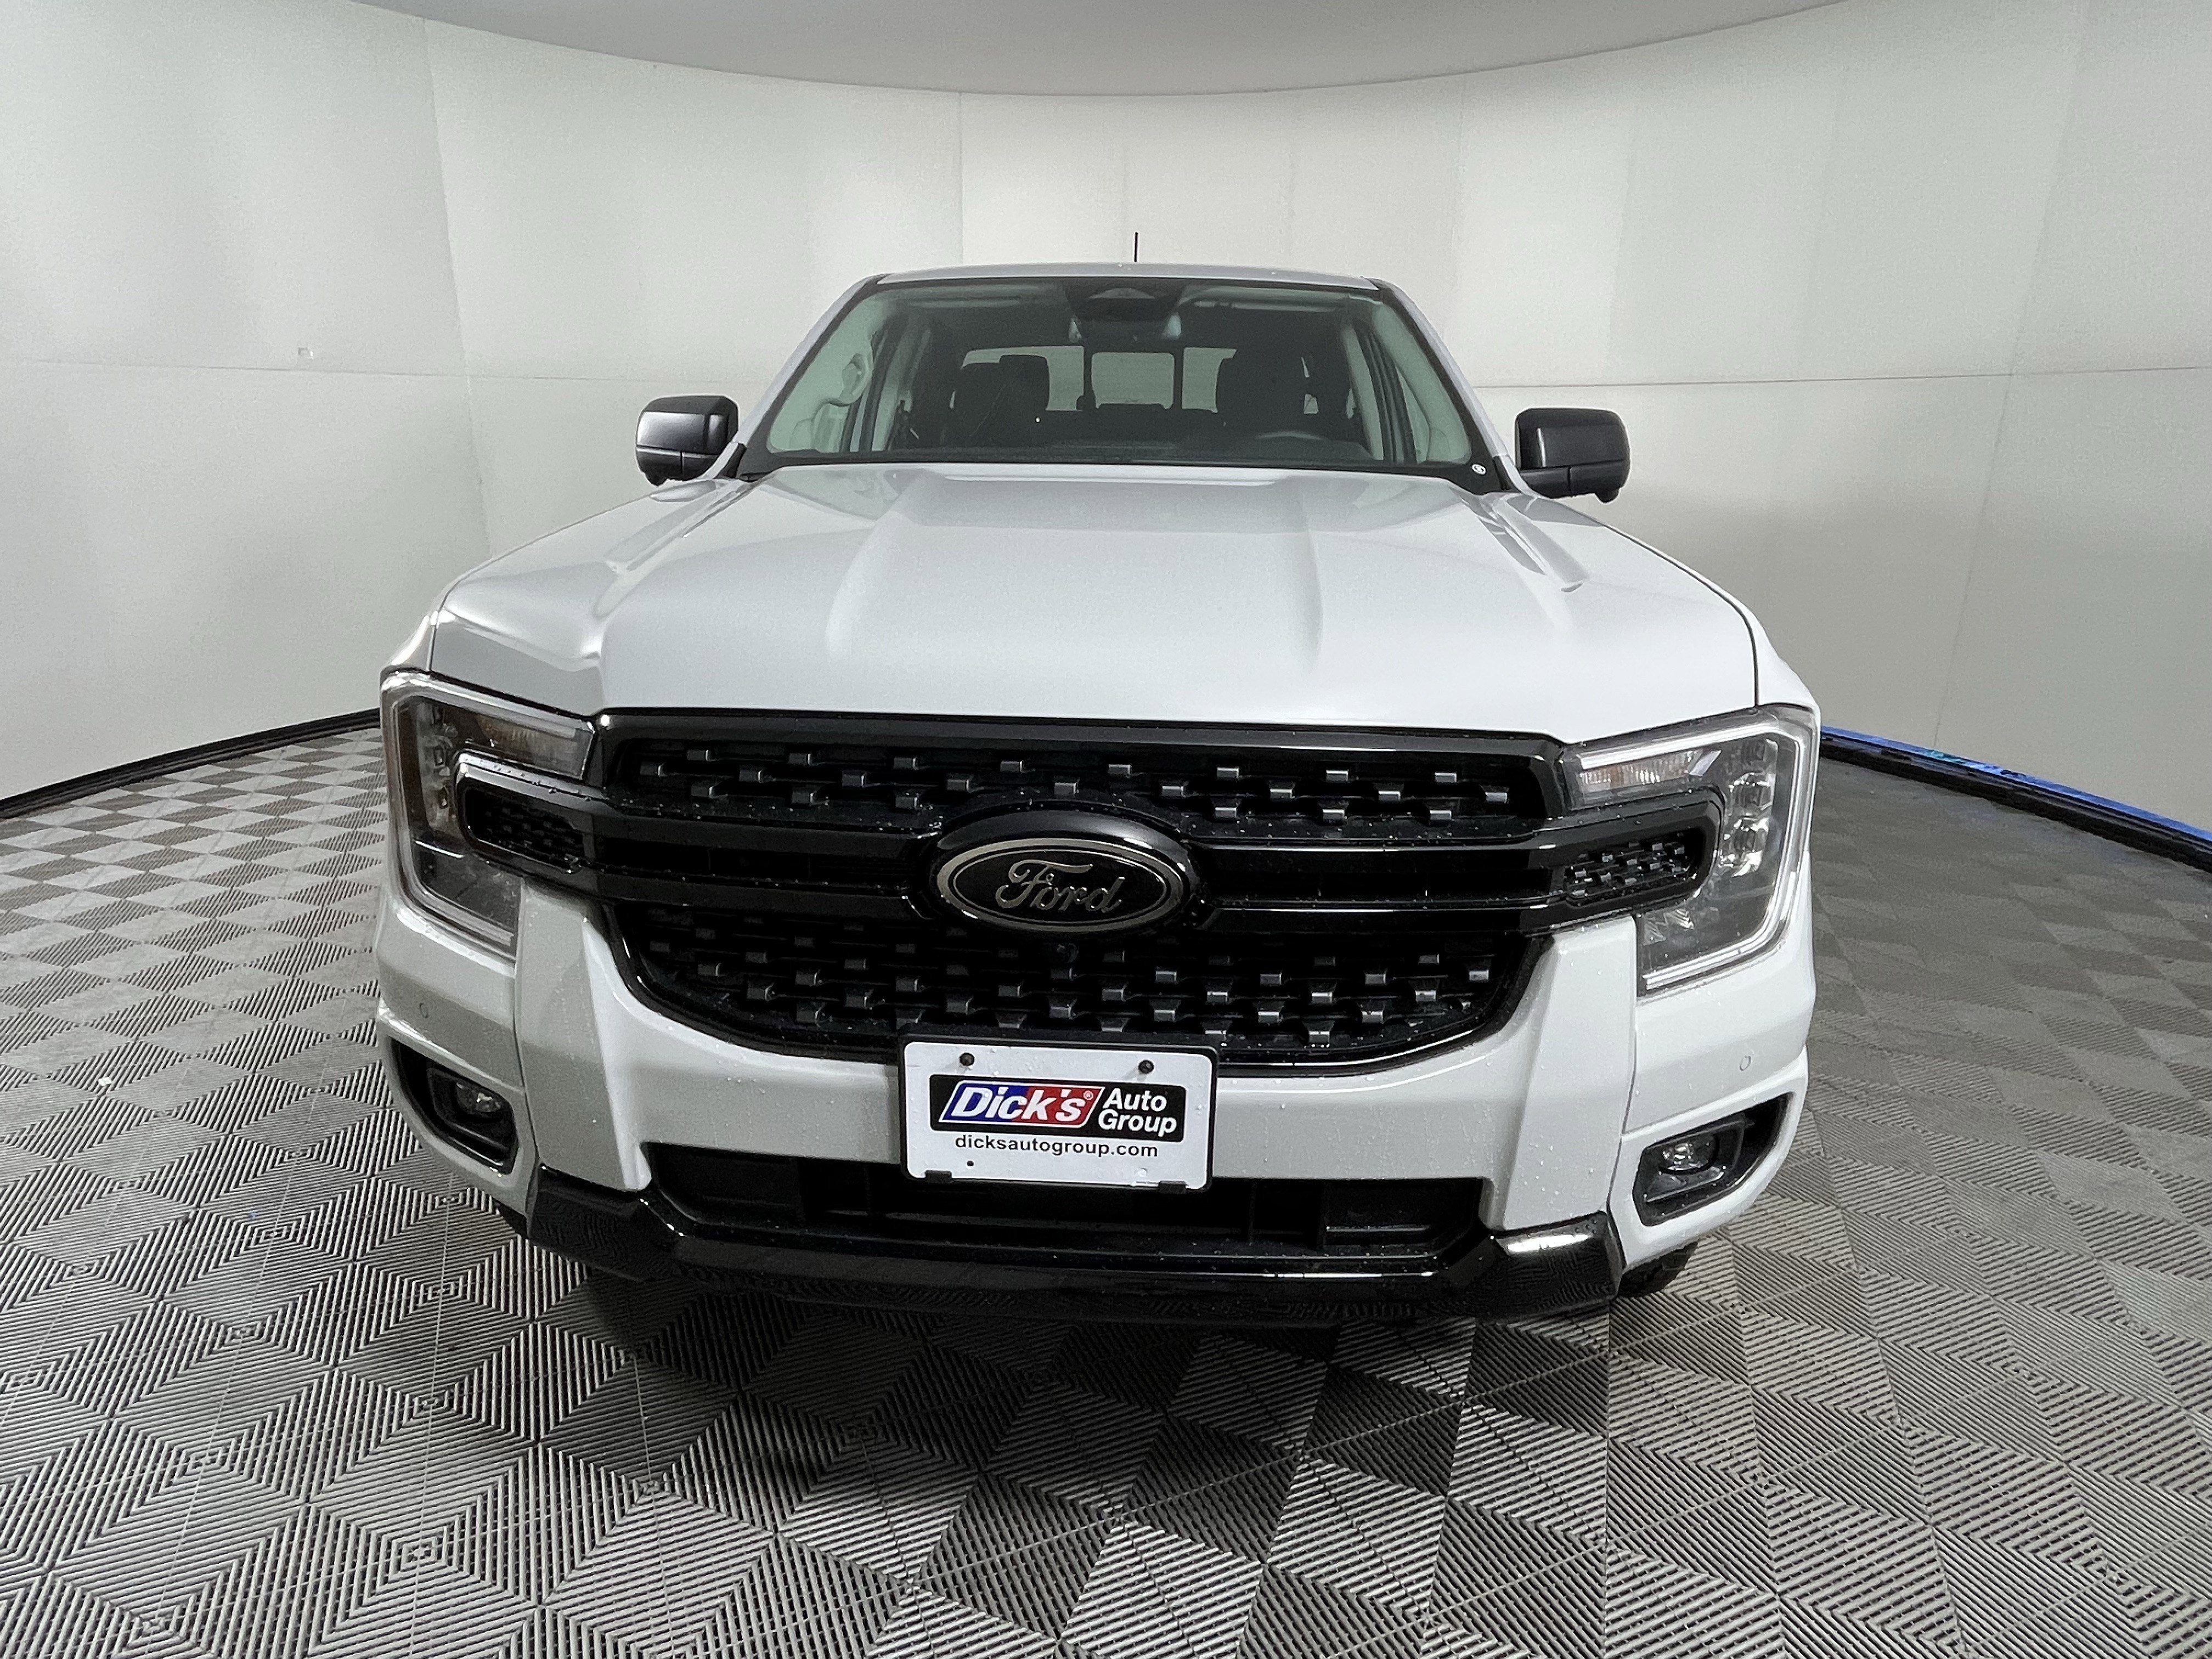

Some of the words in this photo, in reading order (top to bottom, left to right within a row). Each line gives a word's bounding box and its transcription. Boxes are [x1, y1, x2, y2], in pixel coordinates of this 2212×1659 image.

[995, 859, 1126, 913] Ford
[951, 1086, 1085, 1122] Dick's
[1102, 1087, 1167, 1111] Auto
[1098, 1110, 1177, 1137] Group
[955, 1135, 1158, 1157] dicksautogroup.com
